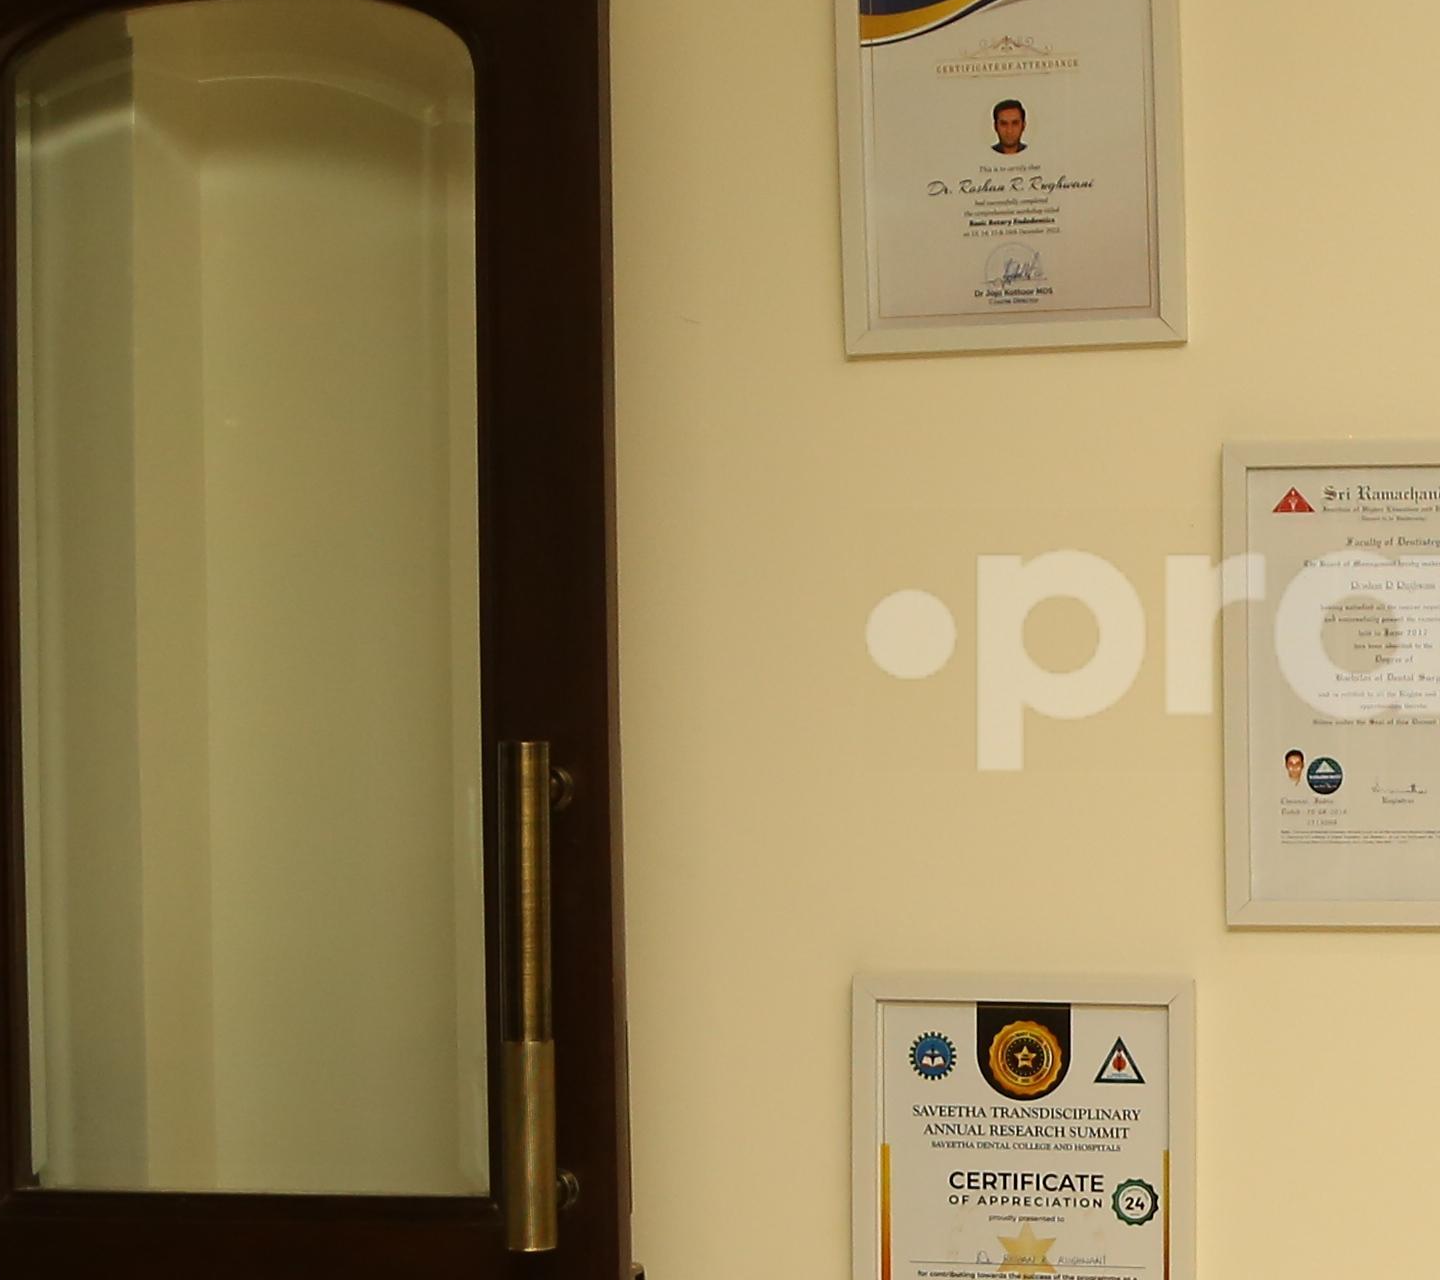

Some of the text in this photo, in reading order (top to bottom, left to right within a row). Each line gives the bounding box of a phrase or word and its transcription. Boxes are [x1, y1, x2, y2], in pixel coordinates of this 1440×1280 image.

[1322, 486, 1350, 501] Sri
[913, 1104, 1141, 1121] SAVEETHA TRANSDISCIPLINARY
[924, 1123, 1130, 1139] ANNUAL RESEARCH SUMMIT
[932, 1141, 975, 1149] SAVEETHA
[977, 1142, 1010, 1150] DENTAL
[1012, 1142, 1052, 1150] COLLEGE
[1075, 1143, 1121, 1152] HOSPITALS
[949, 1171, 1105, 1193] CERTIFICATE
[949, 1195, 1103, 1209] OF APPRECIATION
[1126, 1197, 1145, 1211] 24
